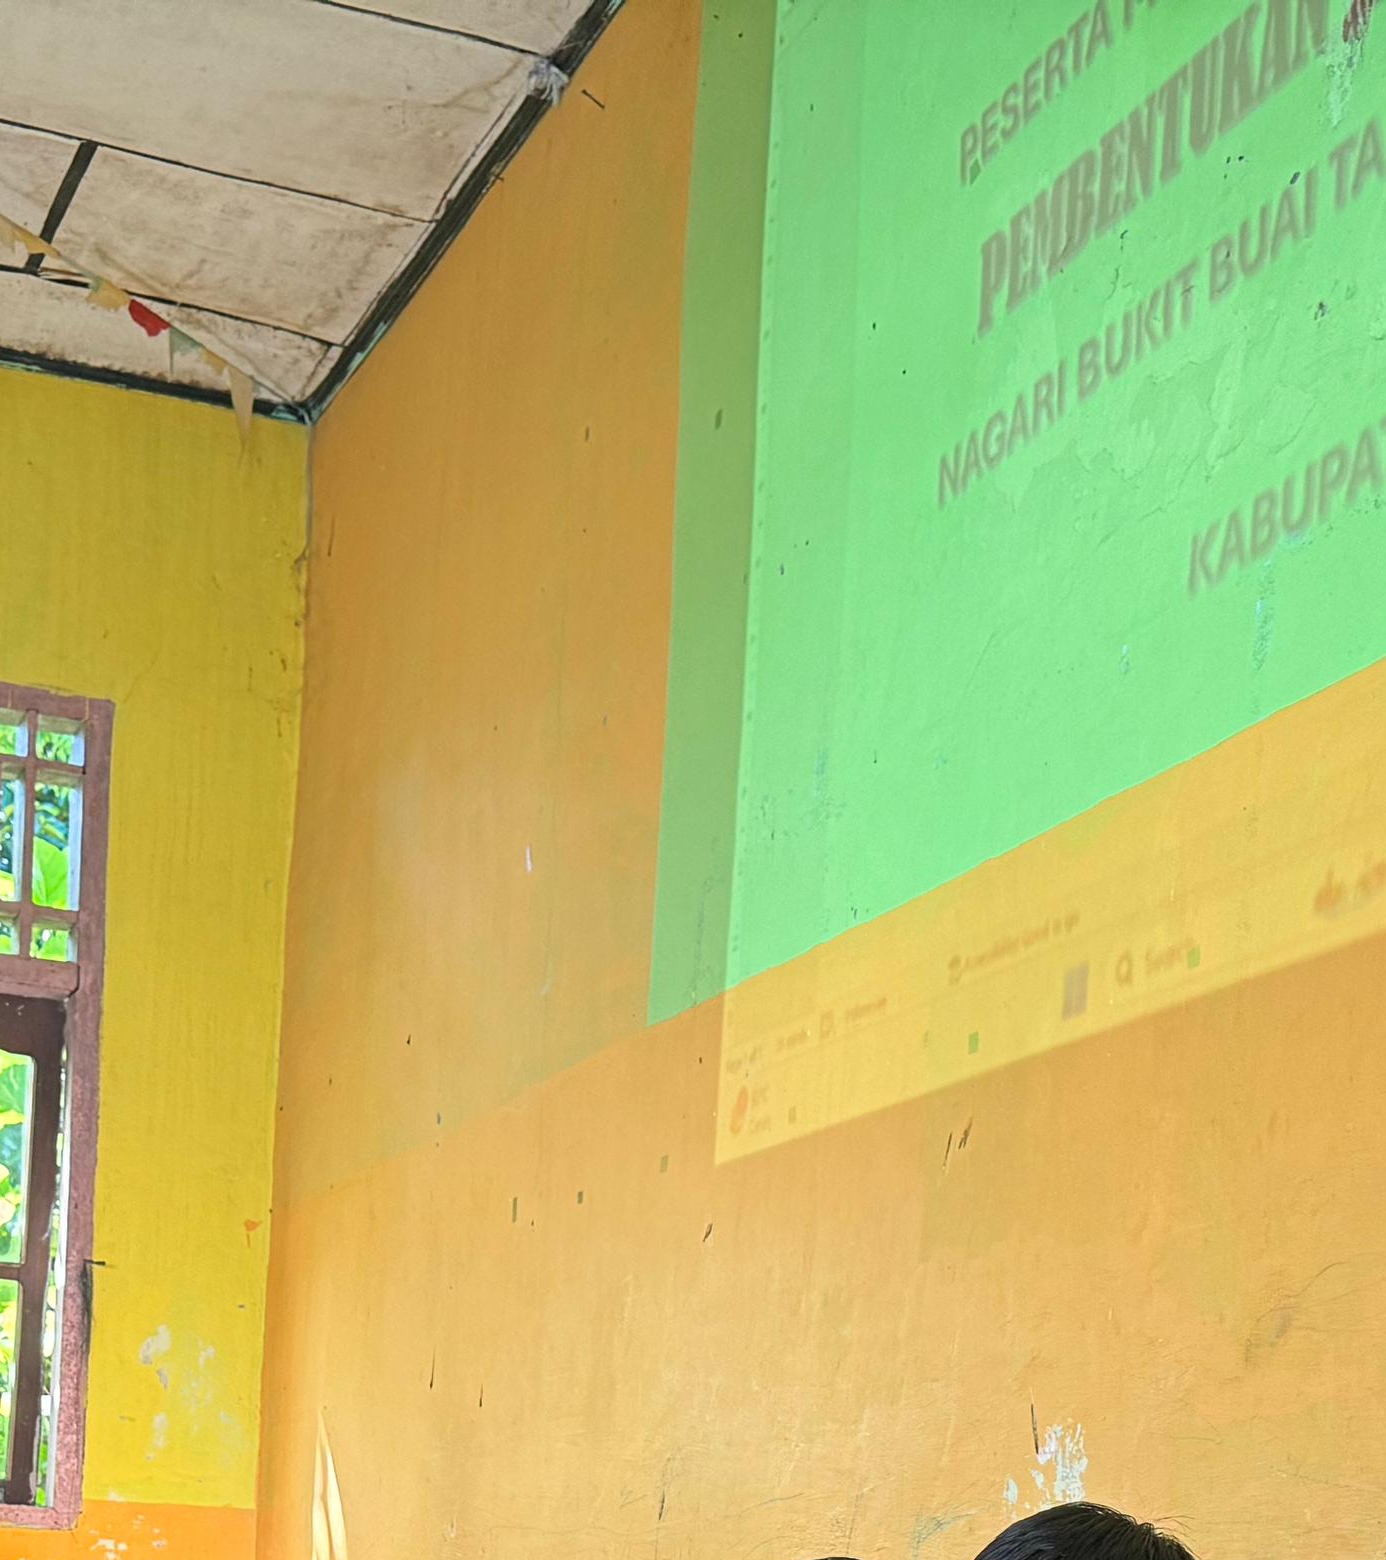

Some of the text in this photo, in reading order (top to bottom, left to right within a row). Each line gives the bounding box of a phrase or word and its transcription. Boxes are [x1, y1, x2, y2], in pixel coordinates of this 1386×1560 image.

[960, 0, 1113, 188] PESERTA
[938, 357, 1068, 510] NAGARI
[1077, 257, 1202, 403] BUKIT
[1209, 163, 1319, 303] BUAI
